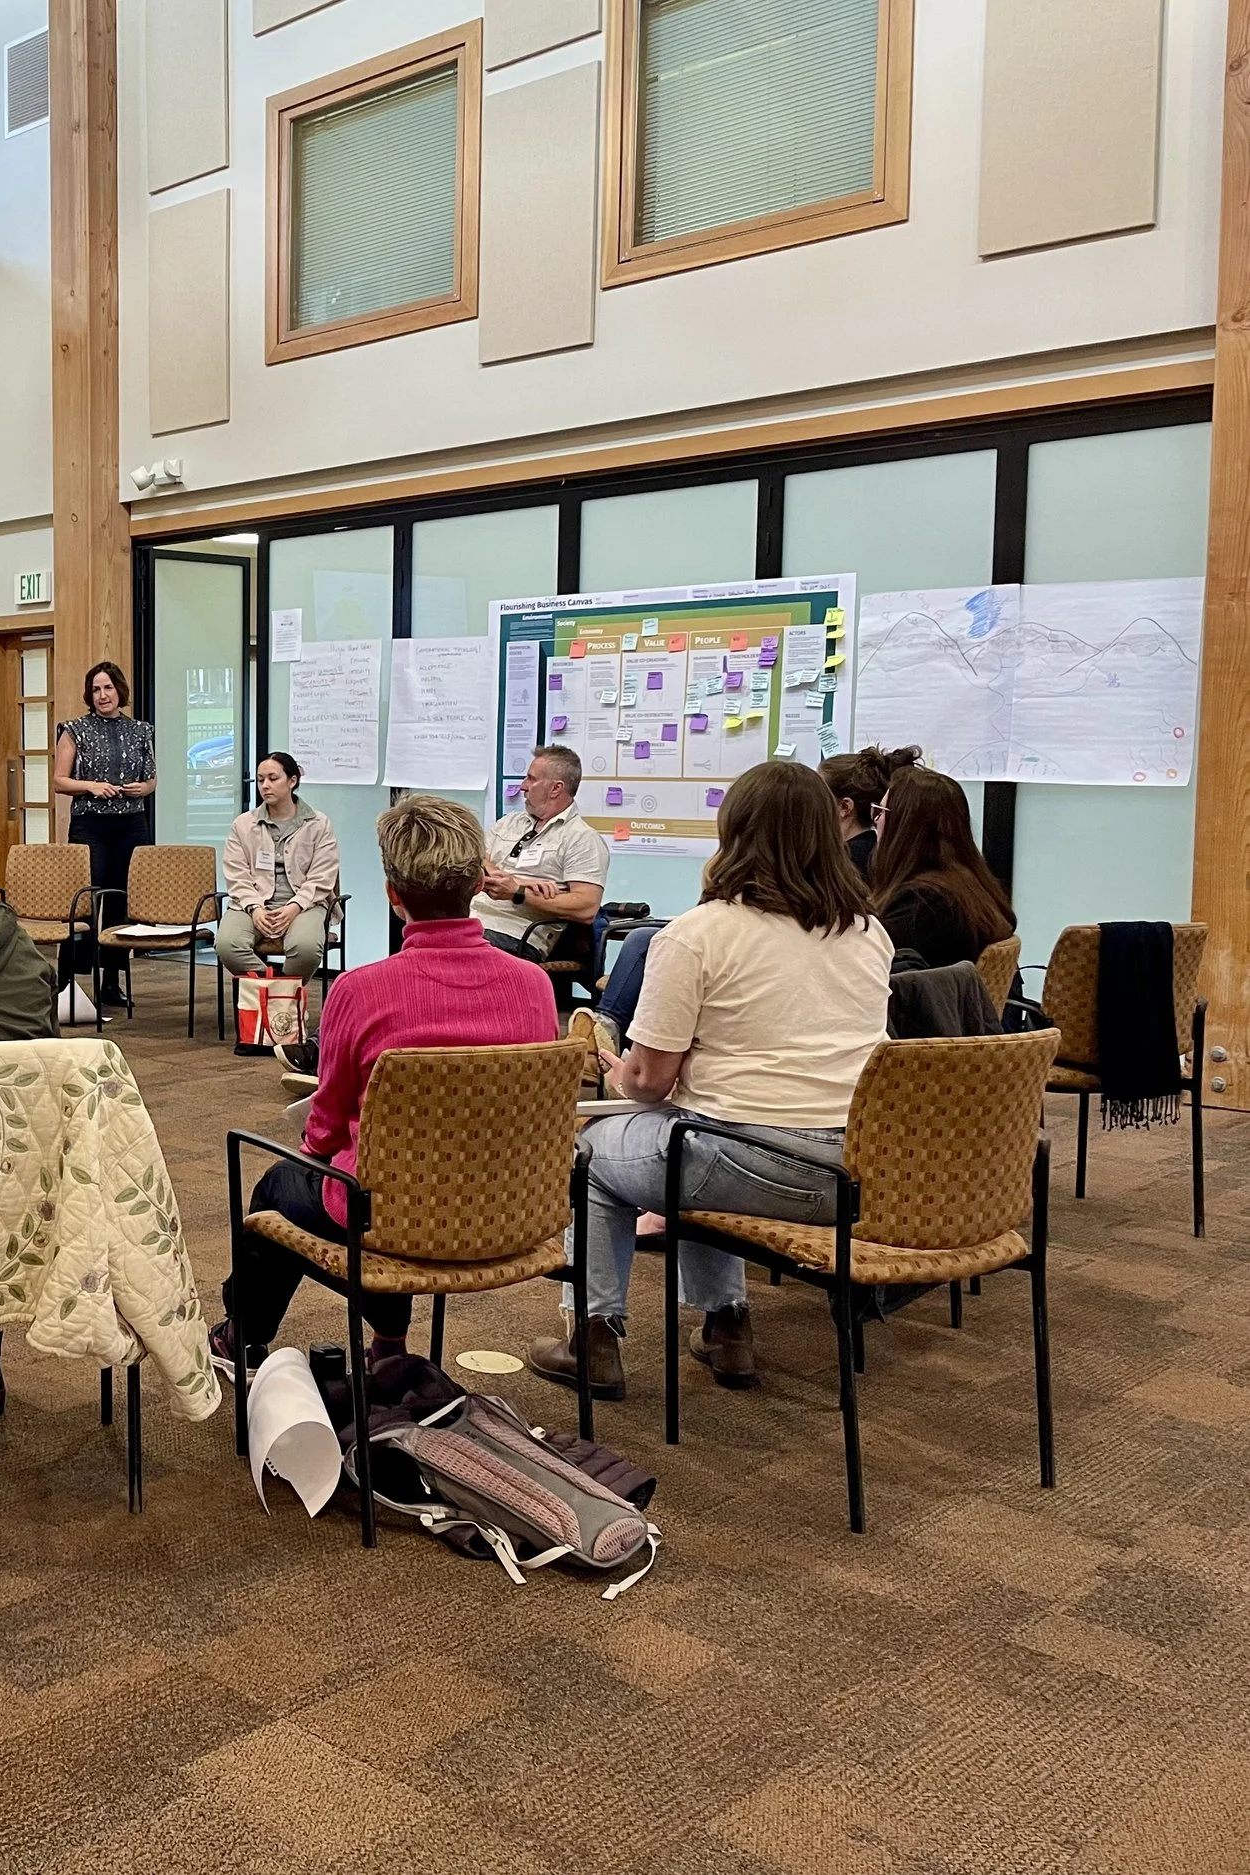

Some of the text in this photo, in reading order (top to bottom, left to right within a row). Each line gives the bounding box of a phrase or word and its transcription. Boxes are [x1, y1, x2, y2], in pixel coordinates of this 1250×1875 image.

[20, 573, 41, 600] EXIT
[500, 602, 536, 611] Flourishing
[537, 600, 566, 608] Business
[644, 638, 666, 648] VALUE
[695, 636, 721, 644] PEOPLE
